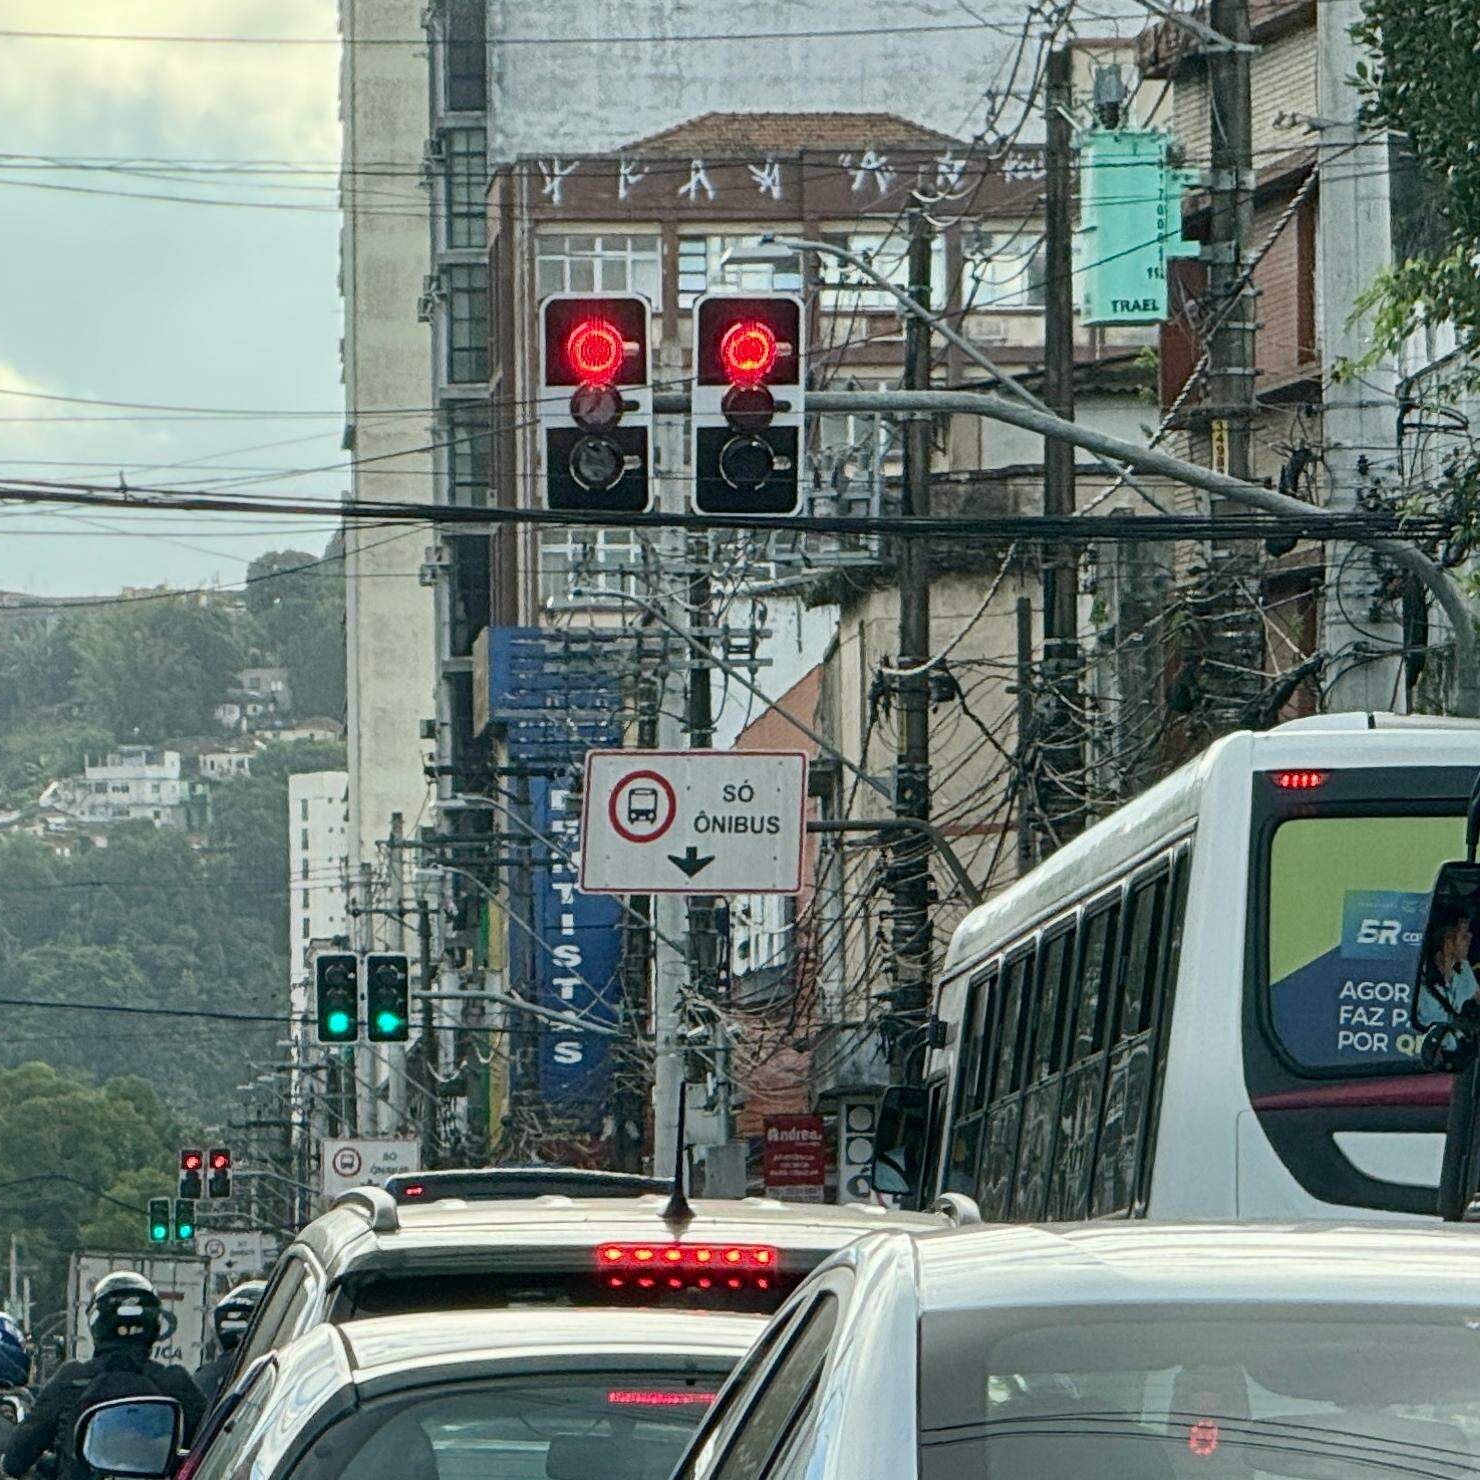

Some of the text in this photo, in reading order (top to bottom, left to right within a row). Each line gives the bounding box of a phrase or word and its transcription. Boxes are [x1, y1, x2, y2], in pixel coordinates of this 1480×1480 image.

[1111, 299, 1160, 313] TRAEL
[722, 779, 755, 802] SÓ
[693, 810, 781, 834] ÔNIBUS
[1339, 981, 1411, 1003] AGOR
[1339, 1005, 1385, 1027] FAZ
[1337, 1030, 1389, 1052] POR
